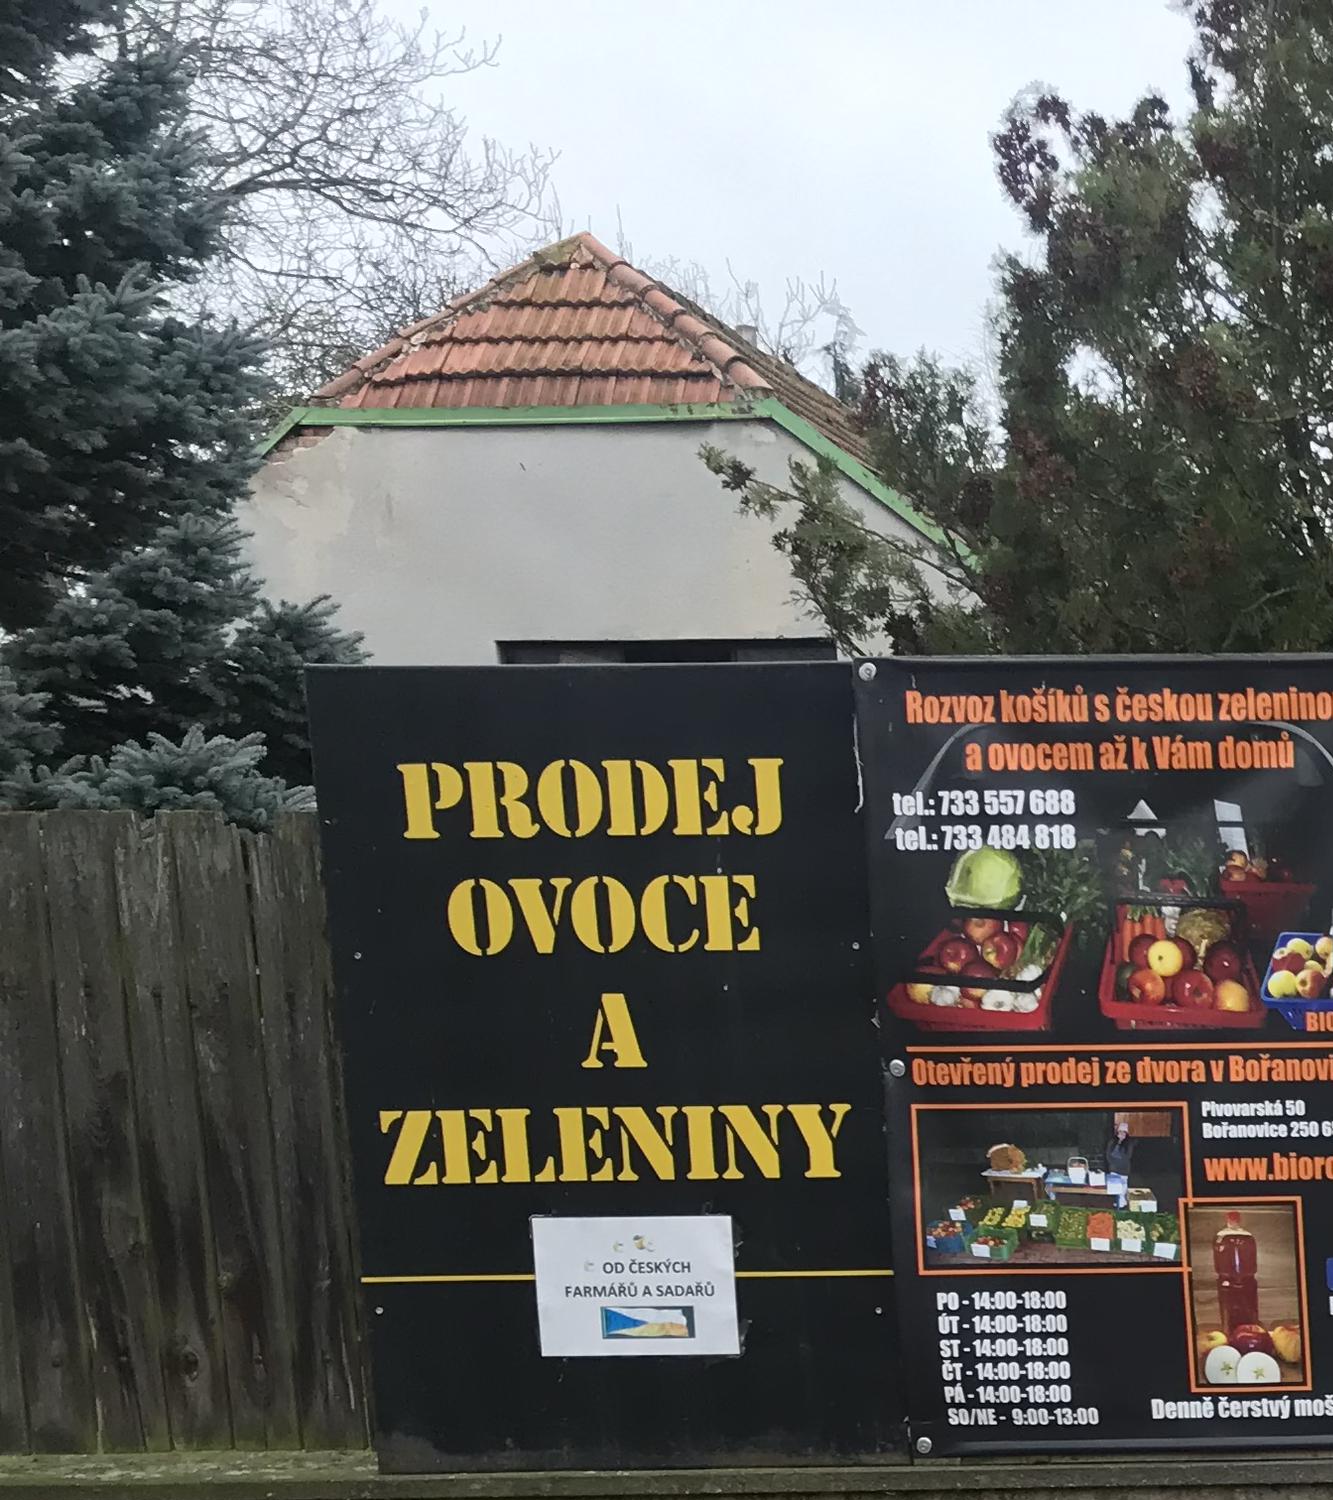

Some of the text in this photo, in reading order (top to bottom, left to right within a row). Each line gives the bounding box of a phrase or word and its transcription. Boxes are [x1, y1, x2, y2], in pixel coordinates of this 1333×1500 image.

[906, 690, 996, 724] Rozvoz
[1000, 684, 1089, 723] košíků
[1095, 694, 1110, 723] s
[1115, 686, 1213, 722] českou
[965, 731, 1295, 771] a ovocem až k Vám domů
[396, 757, 784, 839] PRODEJ
[892, 789, 1076, 816] tel.: 733 557 688
[895, 823, 1077, 850] tel.: 733 484 818
[446, 874, 761, 957] OVOCE
[580, 992, 648, 1069] A
[912, 1057, 1015, 1087] Otevřený
[1020, 1057, 1100, 1087] prodej
[1105, 1061, 1131, 1084] ze
[1136, 1056, 1206, 1083] dvora
[1210, 1060, 1224, 1082] v
[1201, 1100, 1306, 1117] Pivovarská 50
[1202, 1121, 1288, 1139] Bořanovice
[1290, 1121, 1319, 1137] 250
[379, 1103, 851, 1186] ZELENINY
[602, 1259, 691, 1274] OD ČESKÝCH
[565, 1282, 715, 1298] FARMÁŘŮ A SADAŘŮ
[936, 1292, 959, 1311] PO
[971, 1291, 1067, 1310] 14:00-18:00
[938, 1313, 960, 1334] ÚT
[972, 1314, 1068, 1334] 14:00-18:00
[939, 1339, 961, 1358] ST
[972, 1338, 1069, 1357] 14:00-18:00
[942, 1360, 963, 1381] ČT
[975, 1361, 1071, 1380] 14:00-18:00
[944, 1383, 966, 1403] PÁ
[976, 1385, 1072, 1403] 14:00-18:00
[948, 1408, 998, 1425] SO/NE
[1011, 1407, 1099, 1425] 9:00-13:00
[1151, 1397, 1214, 1419] Denně
[1218, 1396, 1291, 1418] čerstvý
